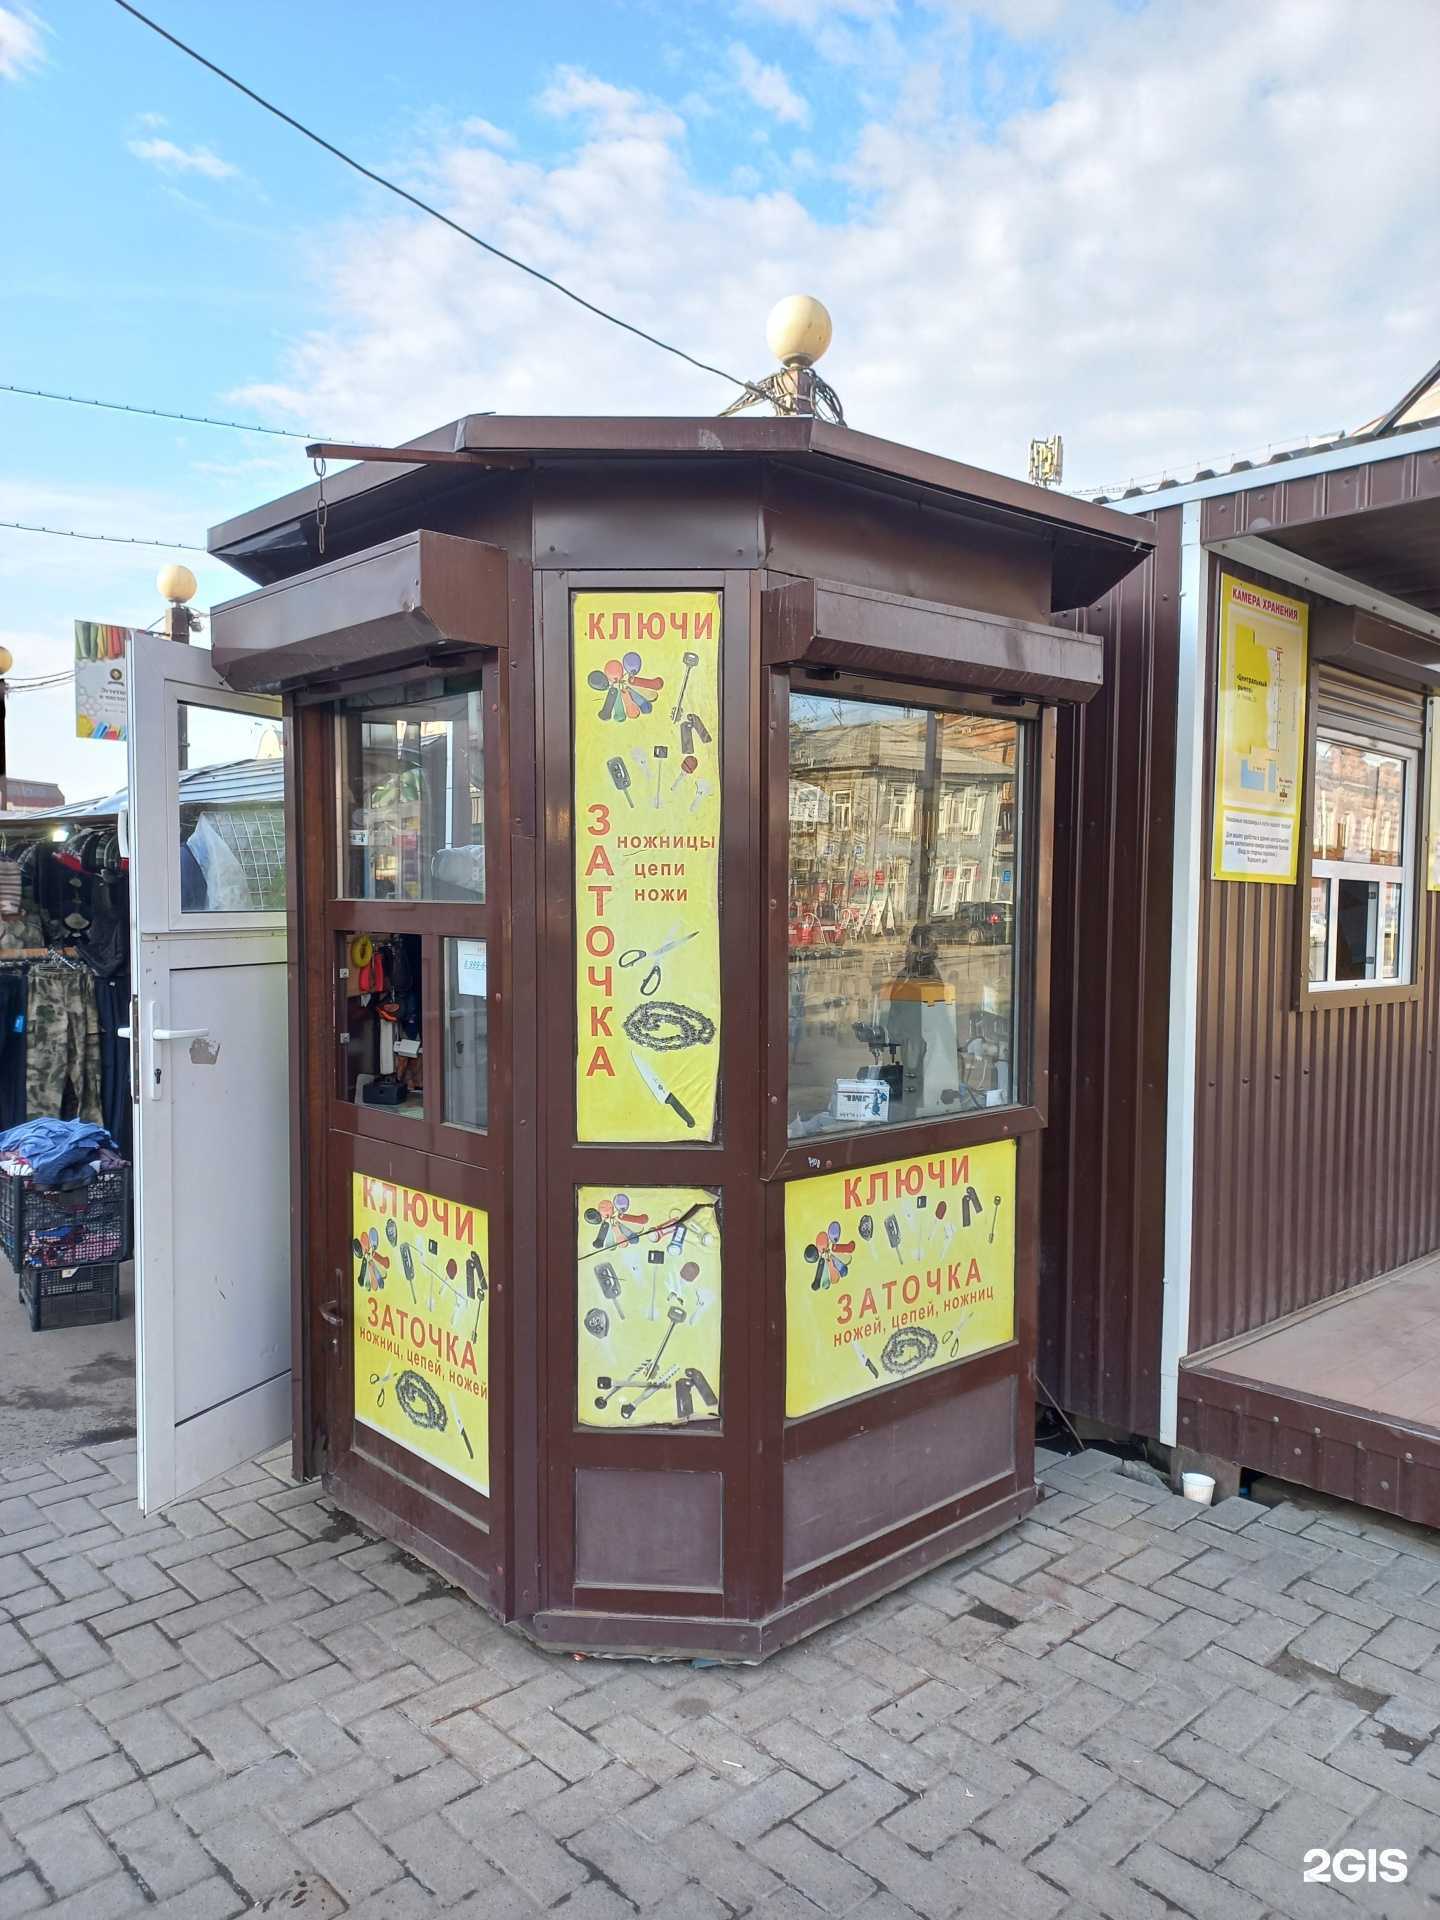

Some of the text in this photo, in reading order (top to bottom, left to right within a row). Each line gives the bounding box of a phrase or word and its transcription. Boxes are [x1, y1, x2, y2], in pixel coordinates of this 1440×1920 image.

[587, 612, 713, 641] КЛЮЧИ
[1232, 587, 1298, 621] КАМЕРА ХРАНЕНИЯ
[617, 834, 716, 851] ножницы
[634, 862, 685, 878] цепи
[634, 888, 688, 902] ножи
[585, 803, 617, 1078] ЗАТОЧКА
[362, 1175, 475, 1247] КЛЮЧИ
[844, 1155, 970, 1210] КЛЮЧИ
[833, 1286, 994, 1347] ножей, цепей, ножниц
[836, 1257, 982, 1326] ЗАТОЧКА
[359, 1327, 488, 1400] ножниц, цепей, ножей
[367, 1296, 478, 1375] ЗАТОЧКА
